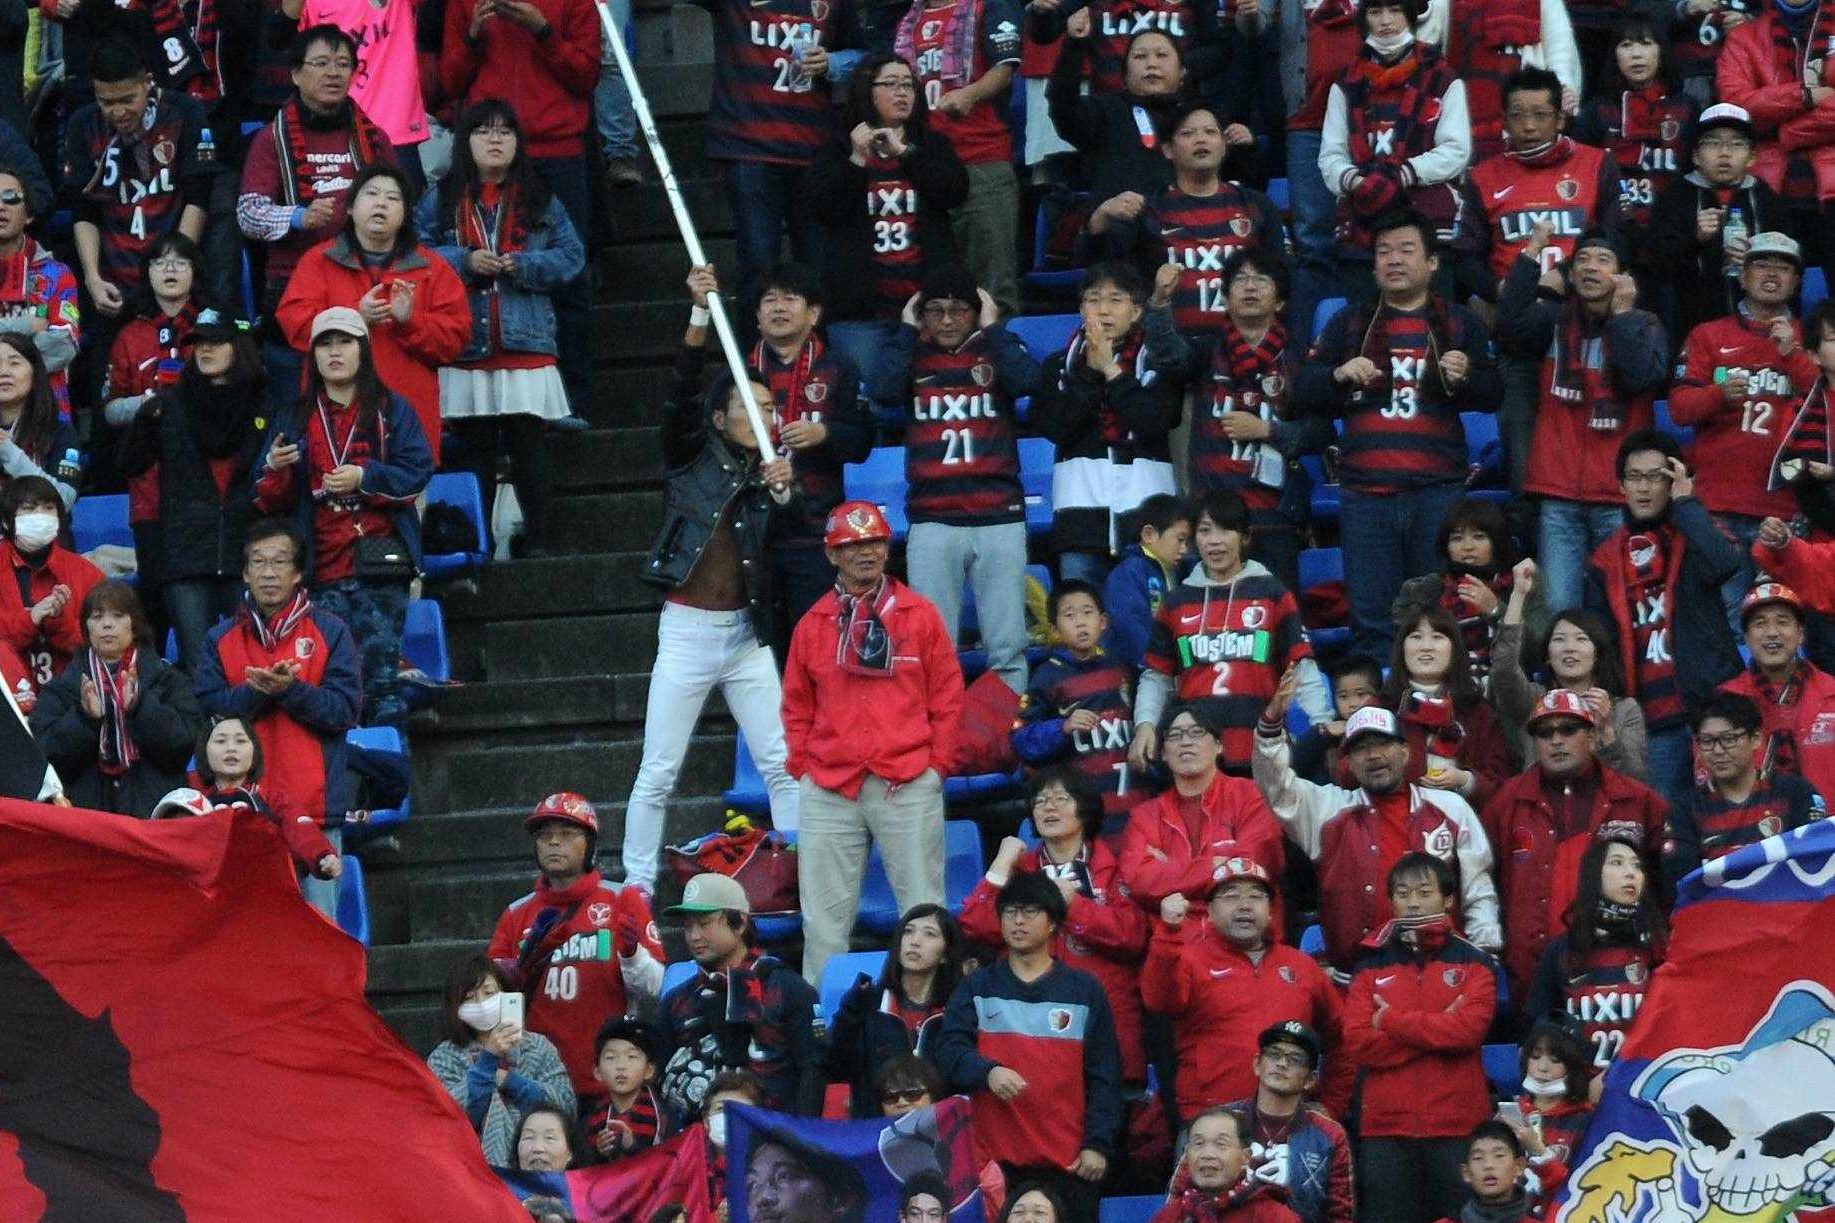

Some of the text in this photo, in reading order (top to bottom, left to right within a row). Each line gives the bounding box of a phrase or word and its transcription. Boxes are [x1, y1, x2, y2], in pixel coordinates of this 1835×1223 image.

[1103, 11, 1183, 37] LIXIL
[874, 221, 908, 252] 33
[1196, 278, 1226, 313] 12
[915, 393, 997, 420] LIXIL
[1740, 401, 1772, 435] 12
[942, 428, 972, 464] 21
[1183, 635, 1256, 665] TOSTEM
[1210, 661, 1229, 696] 2
[1112, 762, 1127, 797] 7
[545, 966, 578, 1000] 40
